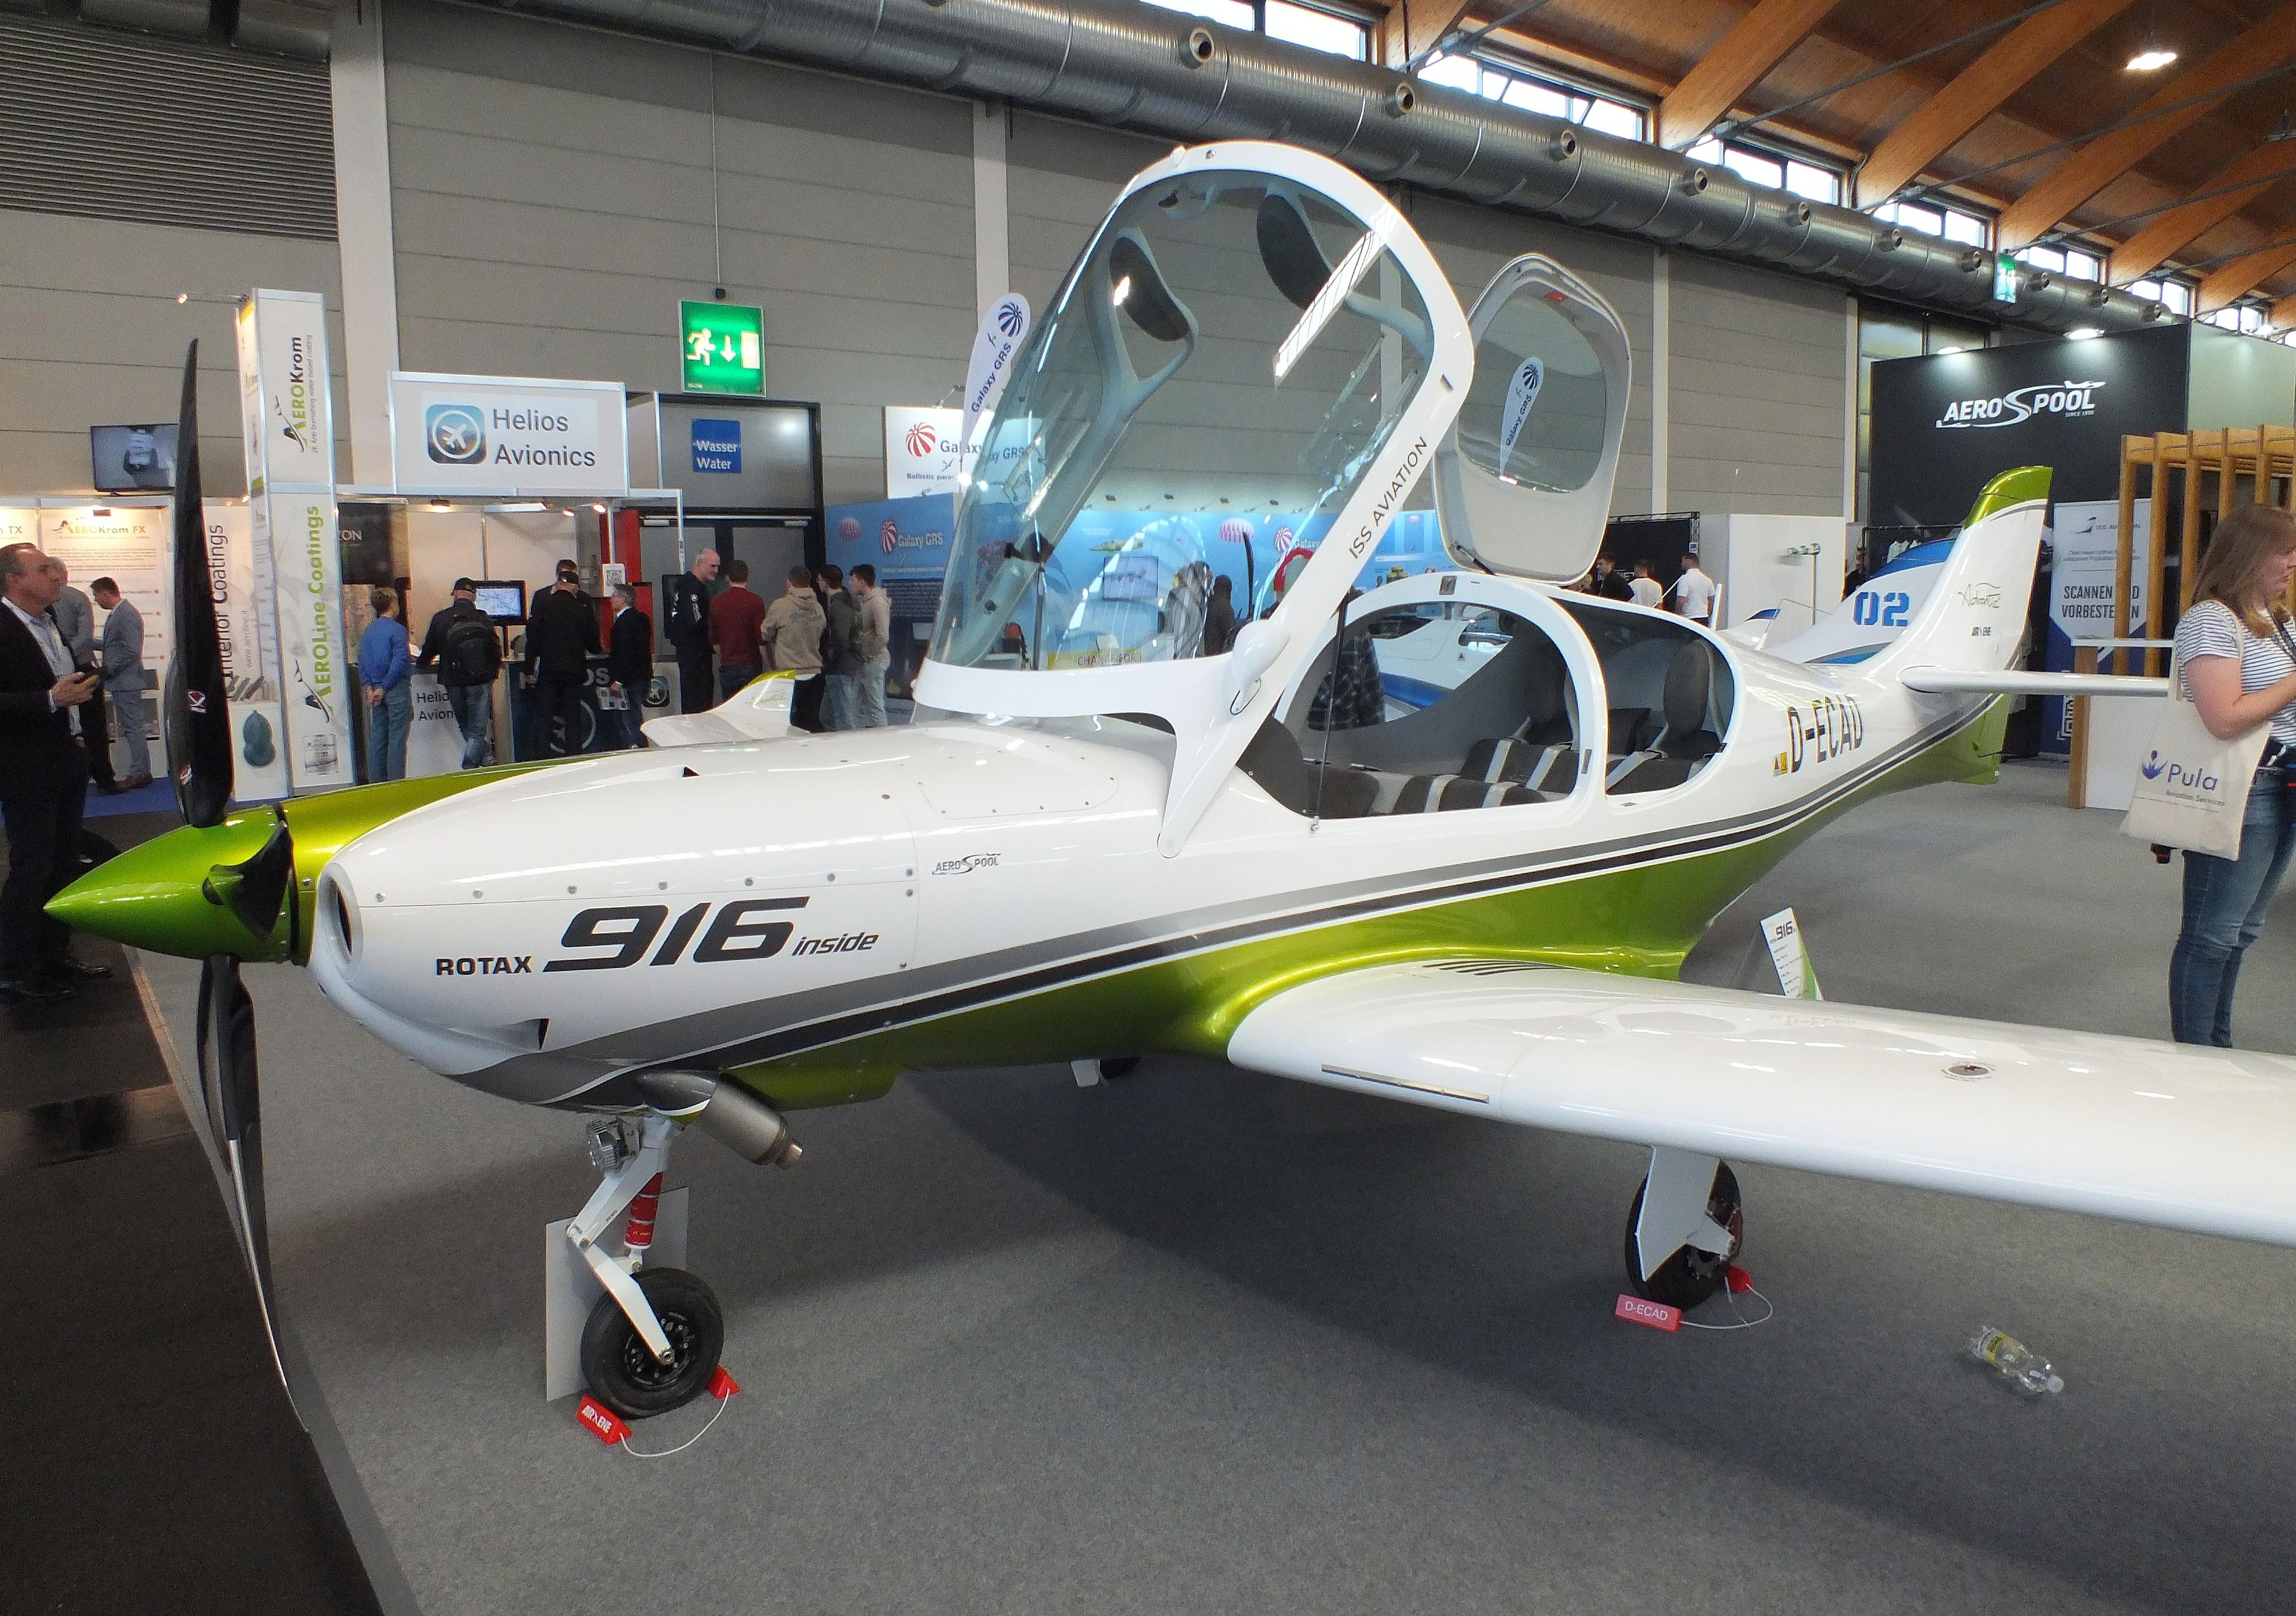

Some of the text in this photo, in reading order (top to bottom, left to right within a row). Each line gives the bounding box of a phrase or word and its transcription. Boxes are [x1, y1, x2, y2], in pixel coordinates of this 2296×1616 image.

[971, 342, 1011, 412] Galaxy GRS
[287, 337, 308, 449] AEROKrom
[1943, 384, 2095, 427] AEROSPOOL
[493, 408, 569, 432] Helios
[1506, 394, 1532, 446] Galaxy GRS
[494, 444, 596, 467] Avionics
[695, 440, 738, 453] Wasser
[696, 457, 732, 471] Water
[1348, 436, 1427, 559] ISS AVIATION
[307, 506, 324, 594] Coatings
[898, 532, 943, 549] Galaxy GRS
[208, 524, 229, 604] Coatings
[2064, 586, 2113, 599] SCANNEN
[1853, 592, 1909, 627] 02
[2062, 605, 2139, 618] VORBESTEN
[417, 691, 450, 703] Helio
[419, 709, 454, 721] Avion
[1786, 695, 1863, 773] D-ECAD
[2167, 763, 2218, 791] Pula
[935, 854, 999, 875] AEROSPOOL
[436, 896, 879, 976] ROTAX 916 inside
[1775, 921, 1793, 940] 916
[1624, 1301, 1668, 1321] D-ECAD
